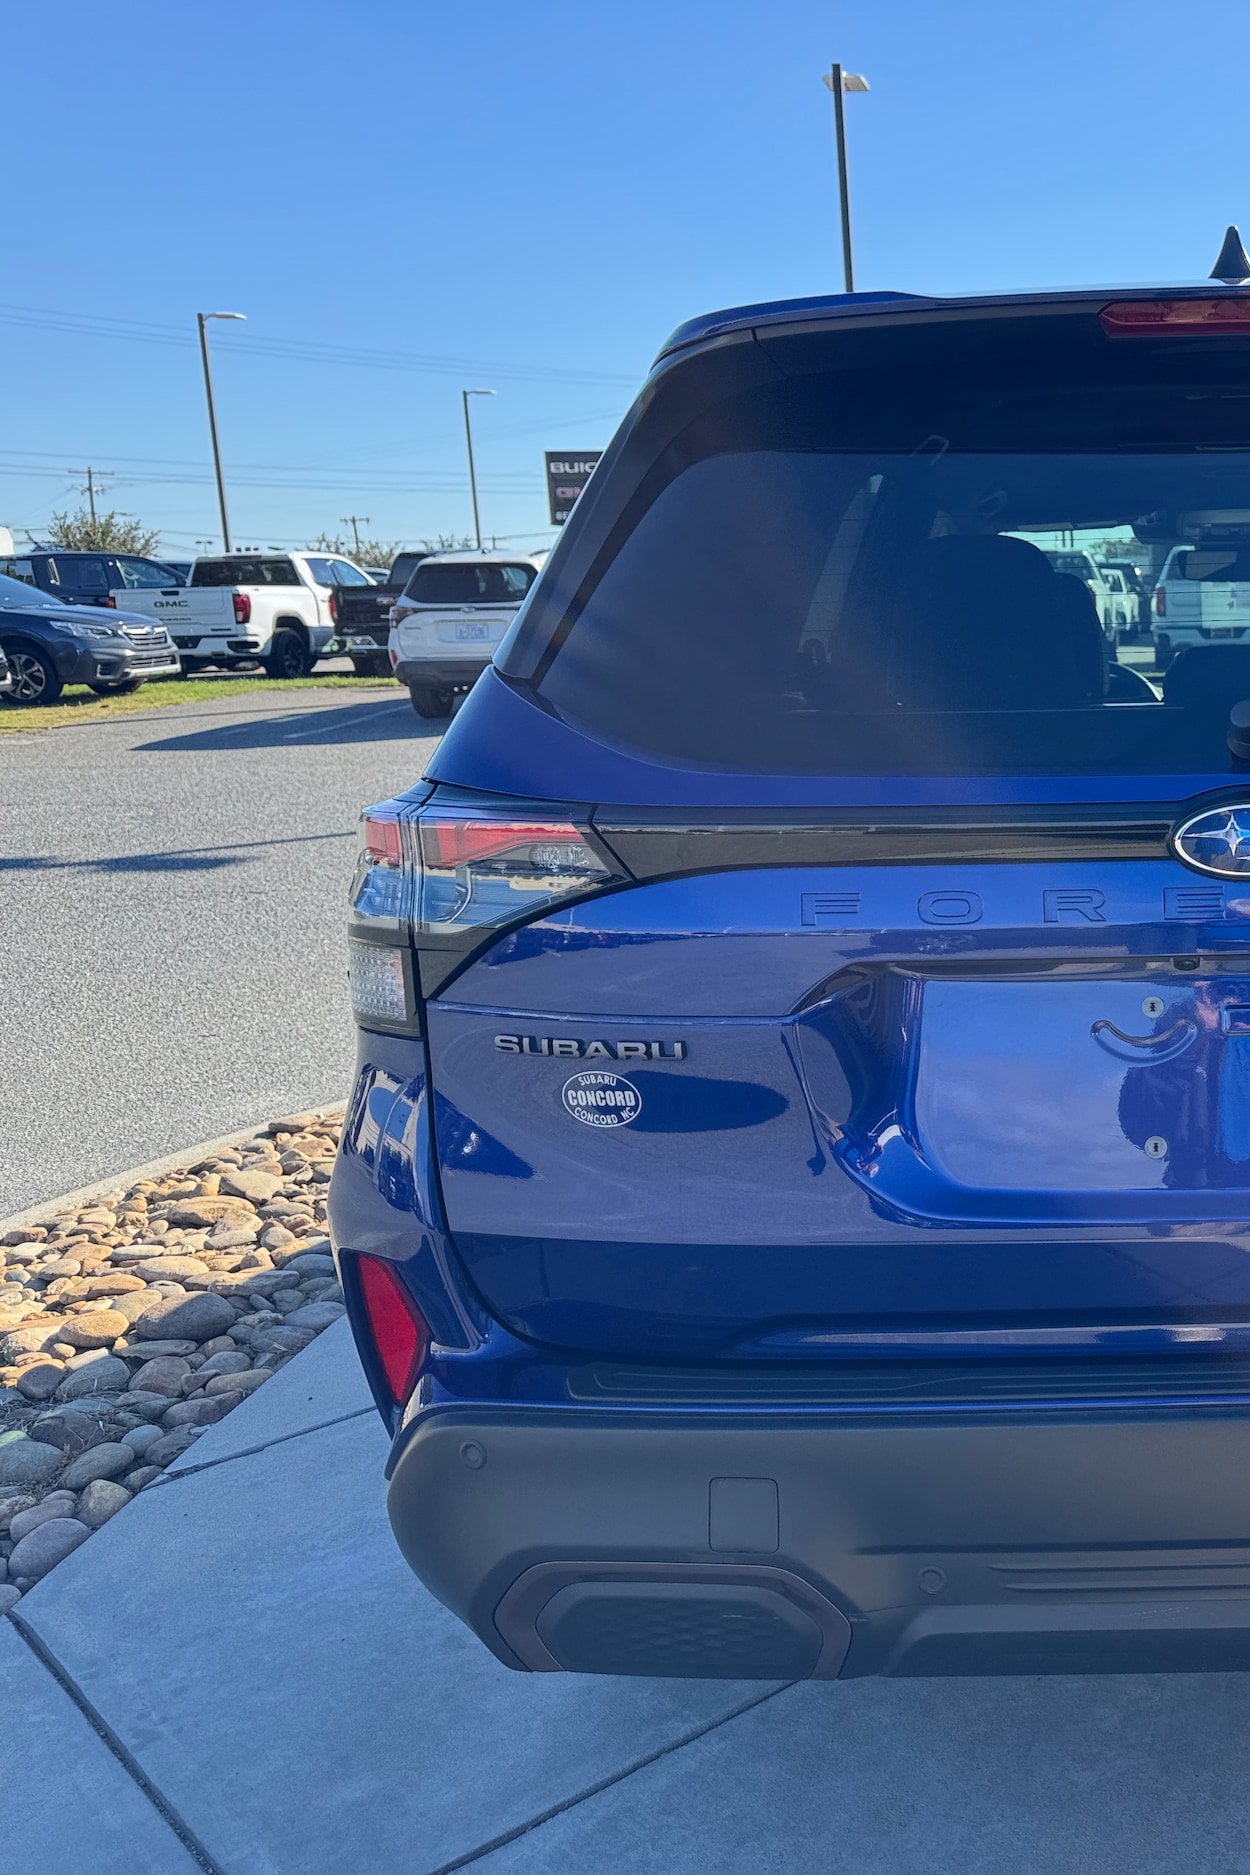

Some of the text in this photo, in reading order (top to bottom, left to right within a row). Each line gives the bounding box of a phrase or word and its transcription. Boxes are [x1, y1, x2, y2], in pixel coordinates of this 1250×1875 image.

[549, 461, 600, 474] BUIC
[153, 600, 190, 608] GMC
[493, 1033, 687, 1061] SUBARU
[578, 1074, 617, 1087] SUBARU
[567, 1089, 636, 1107] CONCORD
[574, 1106, 635, 1125] CONCORD NC
